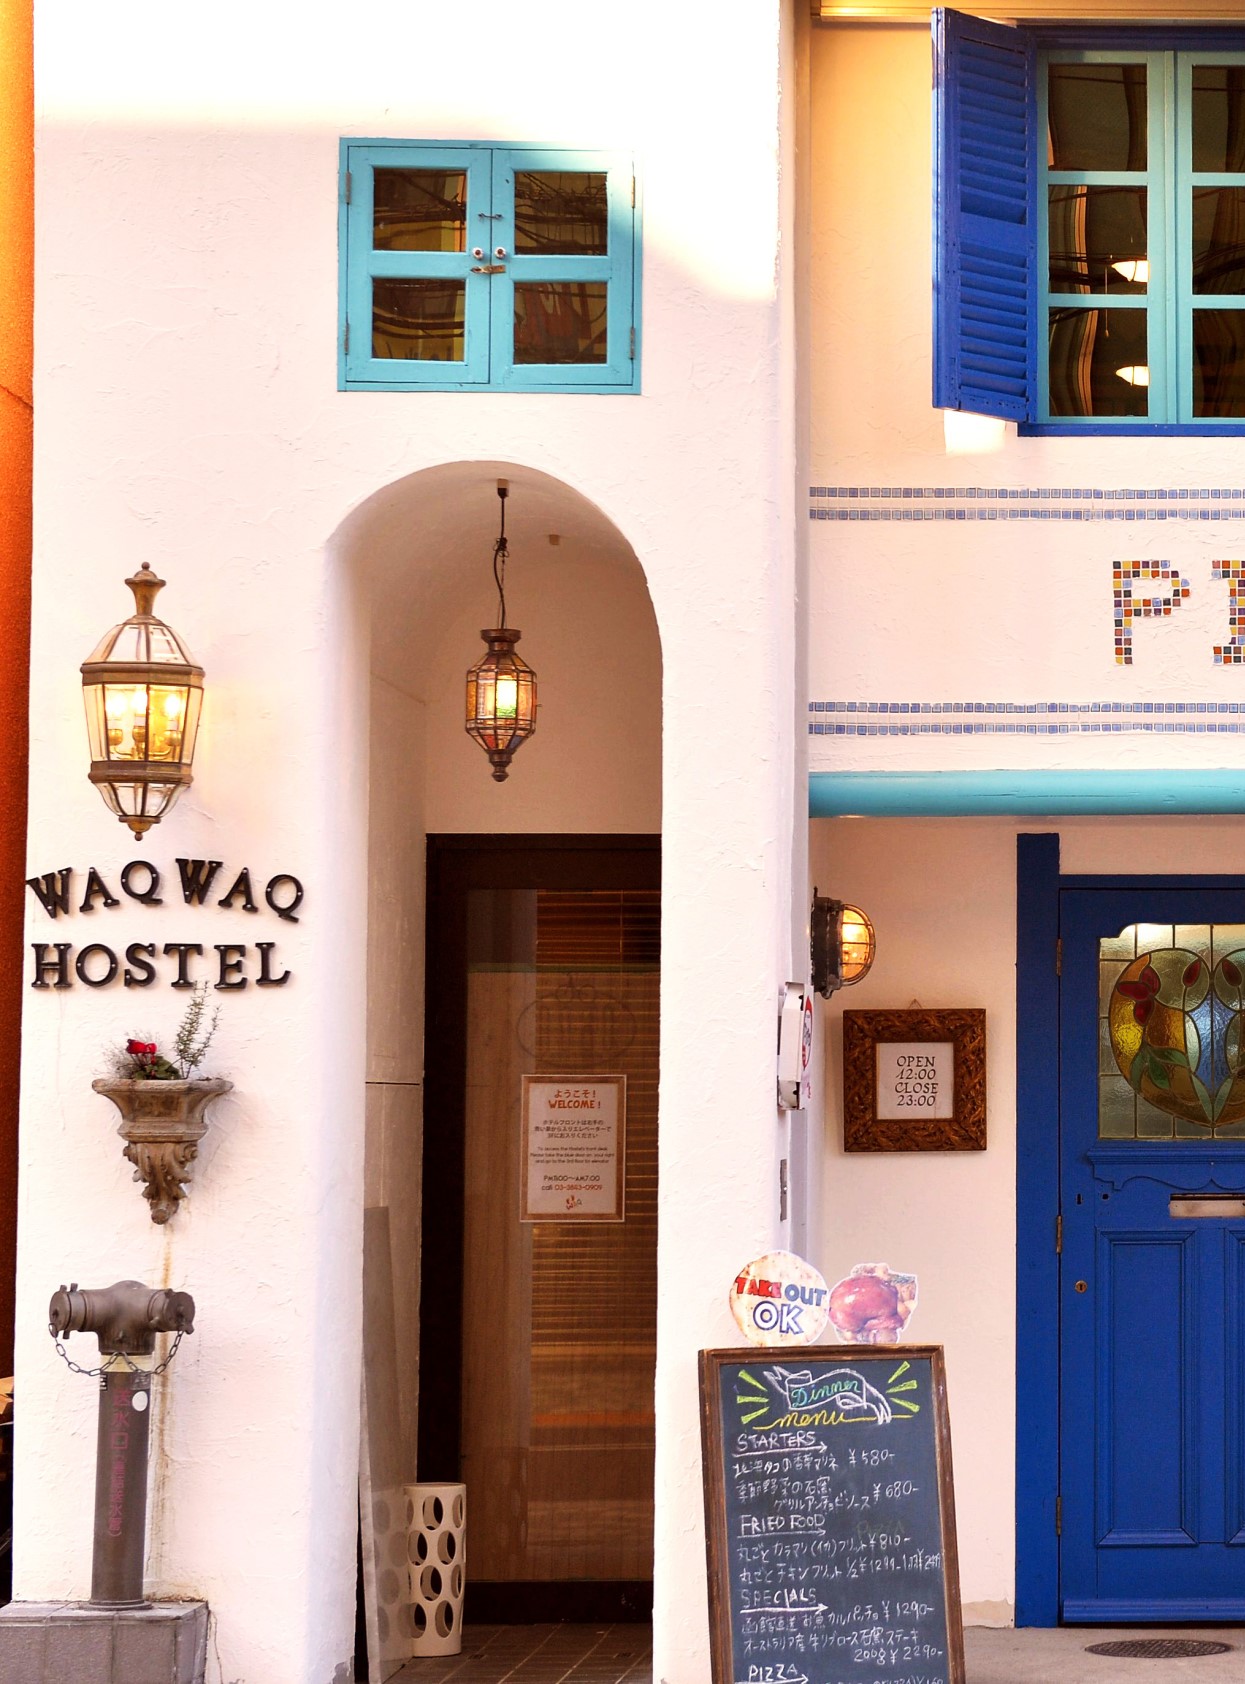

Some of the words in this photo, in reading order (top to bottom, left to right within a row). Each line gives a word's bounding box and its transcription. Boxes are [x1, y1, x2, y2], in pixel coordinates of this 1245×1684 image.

[26, 860, 163, 919] WAQ
[175, 858, 304, 922] WAQ
[31, 942, 291, 990] HOSTEL
[896, 1055, 936, 1067] OPEN
[895, 1069, 936, 1080] 12:00
[895, 1082, 938, 1094] CLOSE
[896, 1095, 936, 1107] 23:00
[735, 1277, 782, 1298] TAKE
[784, 1284, 827, 1307] OUT
[753, 1301, 803, 1334] OK
[791, 1379, 861, 1408] Dinner
[768, 1410, 850, 1429] menu
[737, 1432, 816, 1450] STARTERS
[740, 1514, 785, 1536] FRIED
[790, 1513, 825, 1529] FOOD
[741, 1588, 816, 1608] SPECIALS
[749, 1663, 797, 1682] PIZZA
